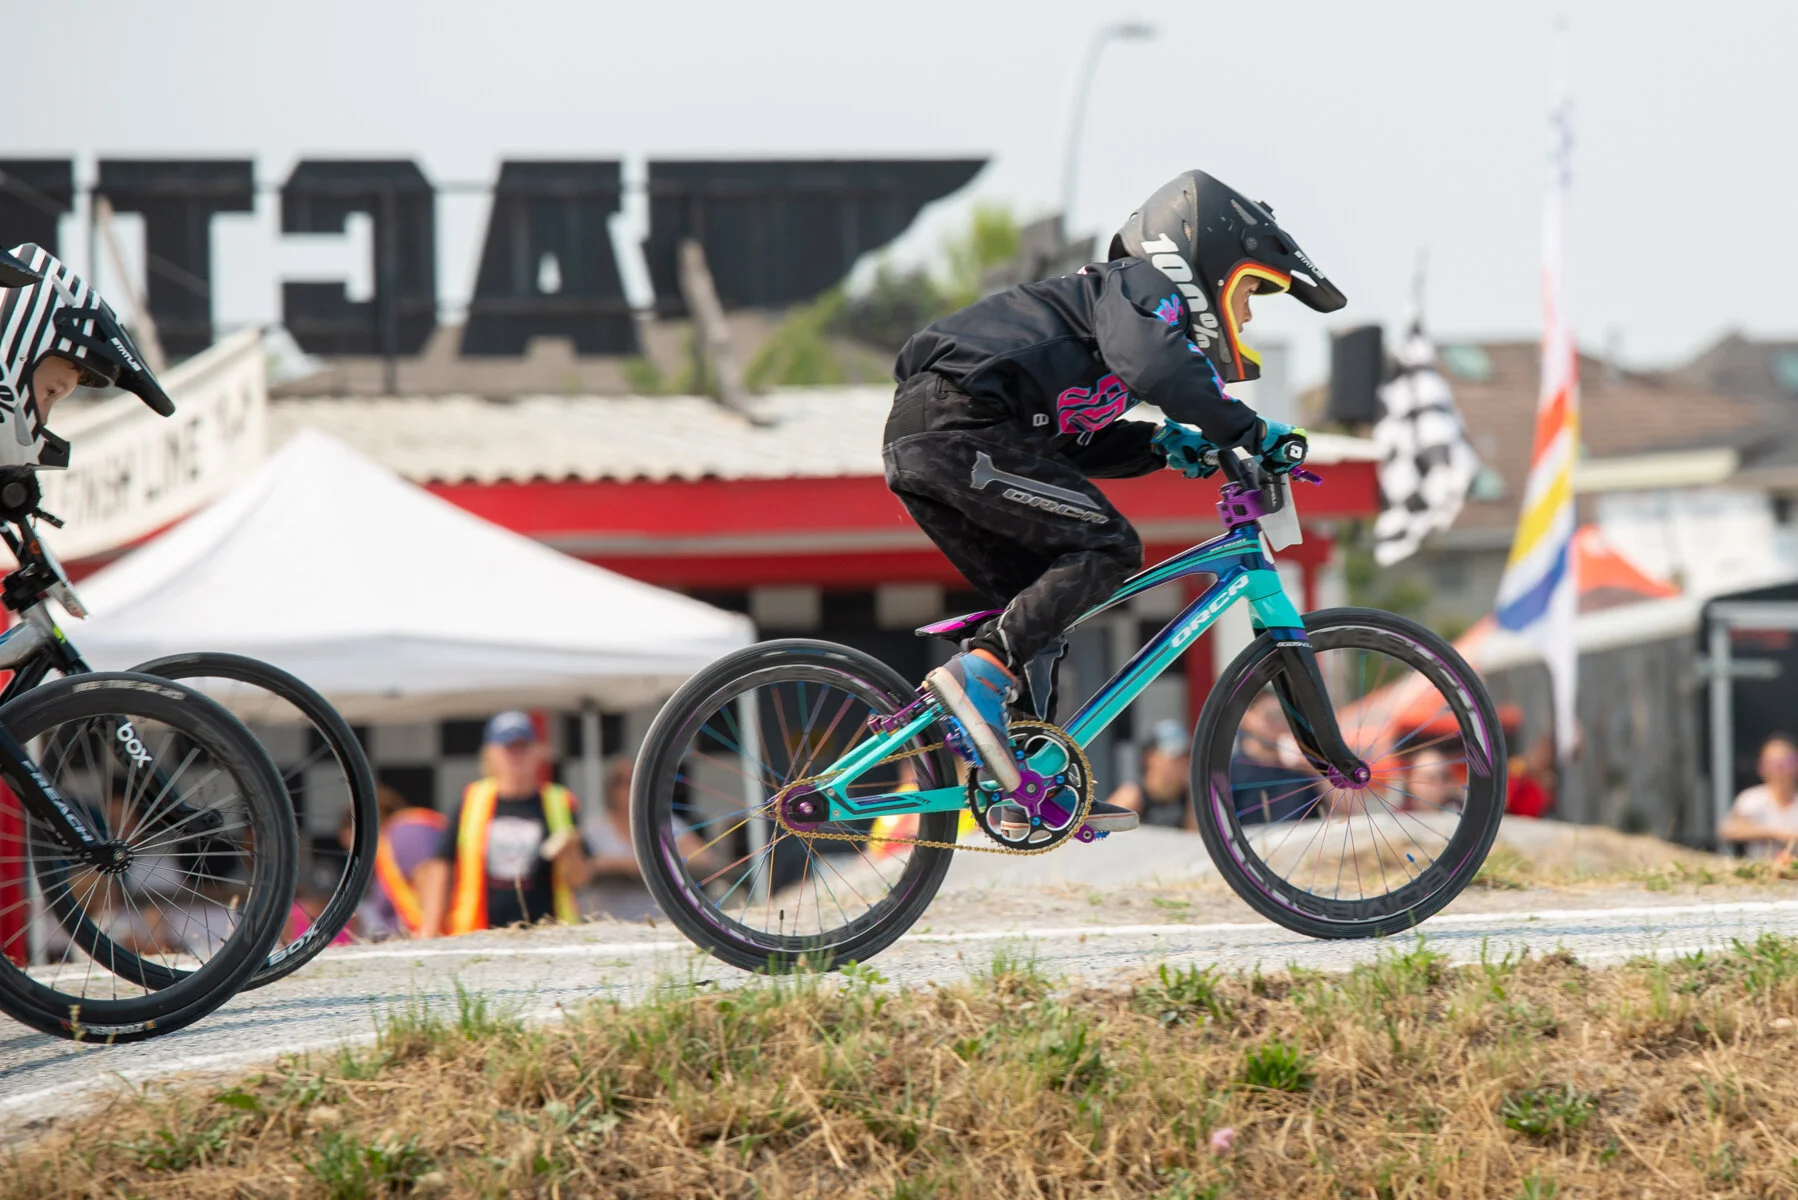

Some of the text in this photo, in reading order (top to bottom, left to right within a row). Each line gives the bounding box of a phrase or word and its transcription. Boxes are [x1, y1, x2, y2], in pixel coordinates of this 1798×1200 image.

[1294, 250, 1325, 280] STATUS
[1141, 232, 1220, 349] 100%
[111, 337, 142, 372] STATUS
[116, 722, 154, 770] box
[267, 922, 321, 968] BOX
